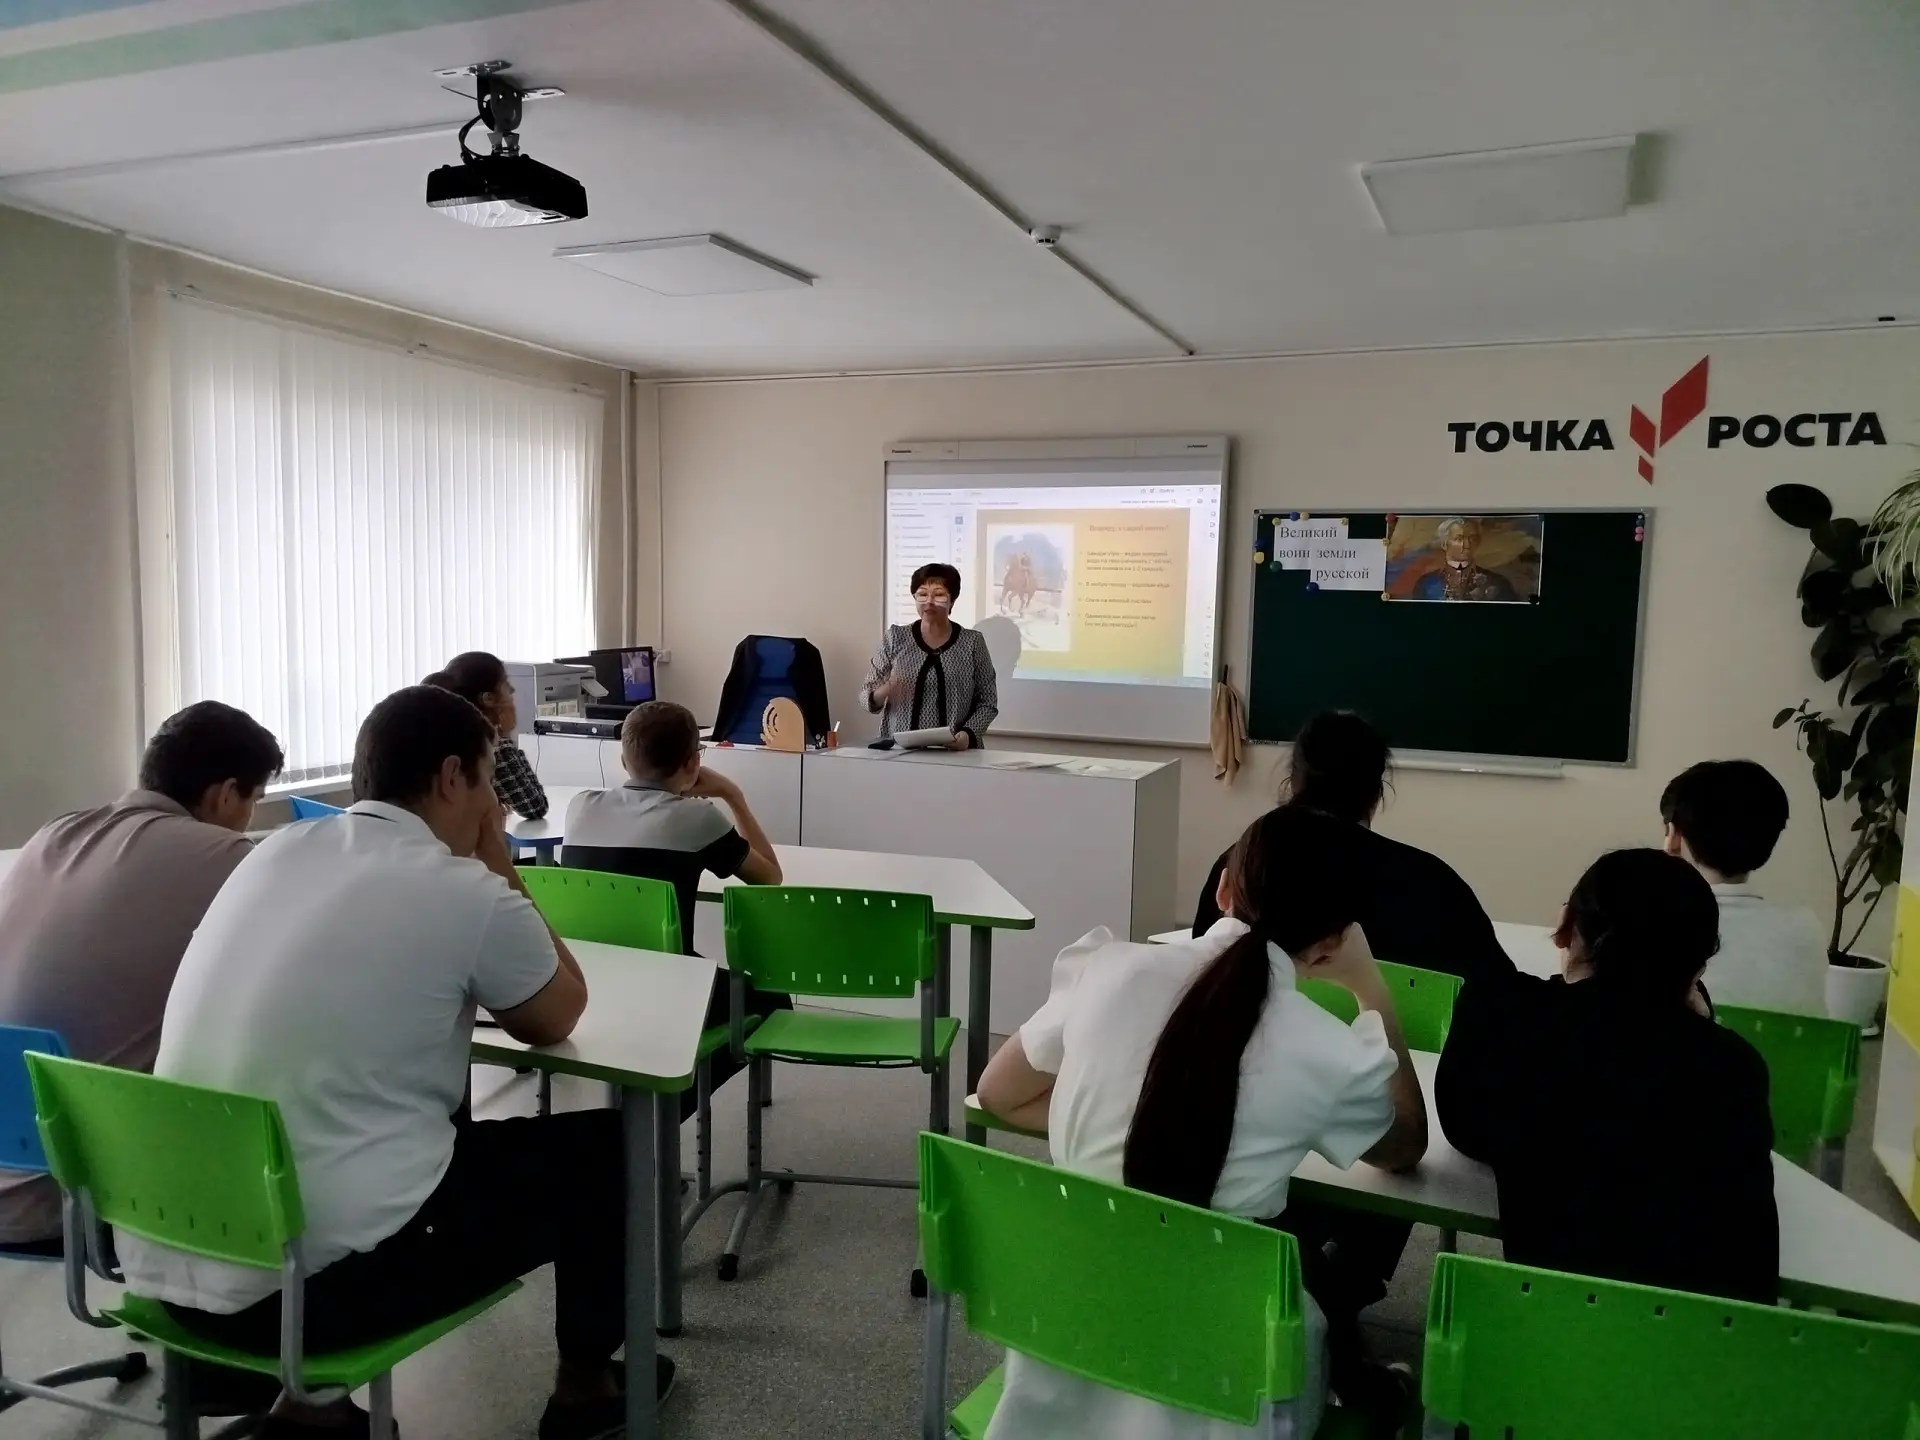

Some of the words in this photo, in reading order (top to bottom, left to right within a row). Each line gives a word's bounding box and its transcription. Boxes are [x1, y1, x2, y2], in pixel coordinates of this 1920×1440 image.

[1447, 418, 1615, 453] ТОЧКА
[1707, 411, 1888, 449] РОСТА
[1280, 526, 1338, 538] Великий
[1279, 549, 1311, 559] воин
[1315, 549, 1357, 559] земли
[1315, 567, 1370, 581] русской
